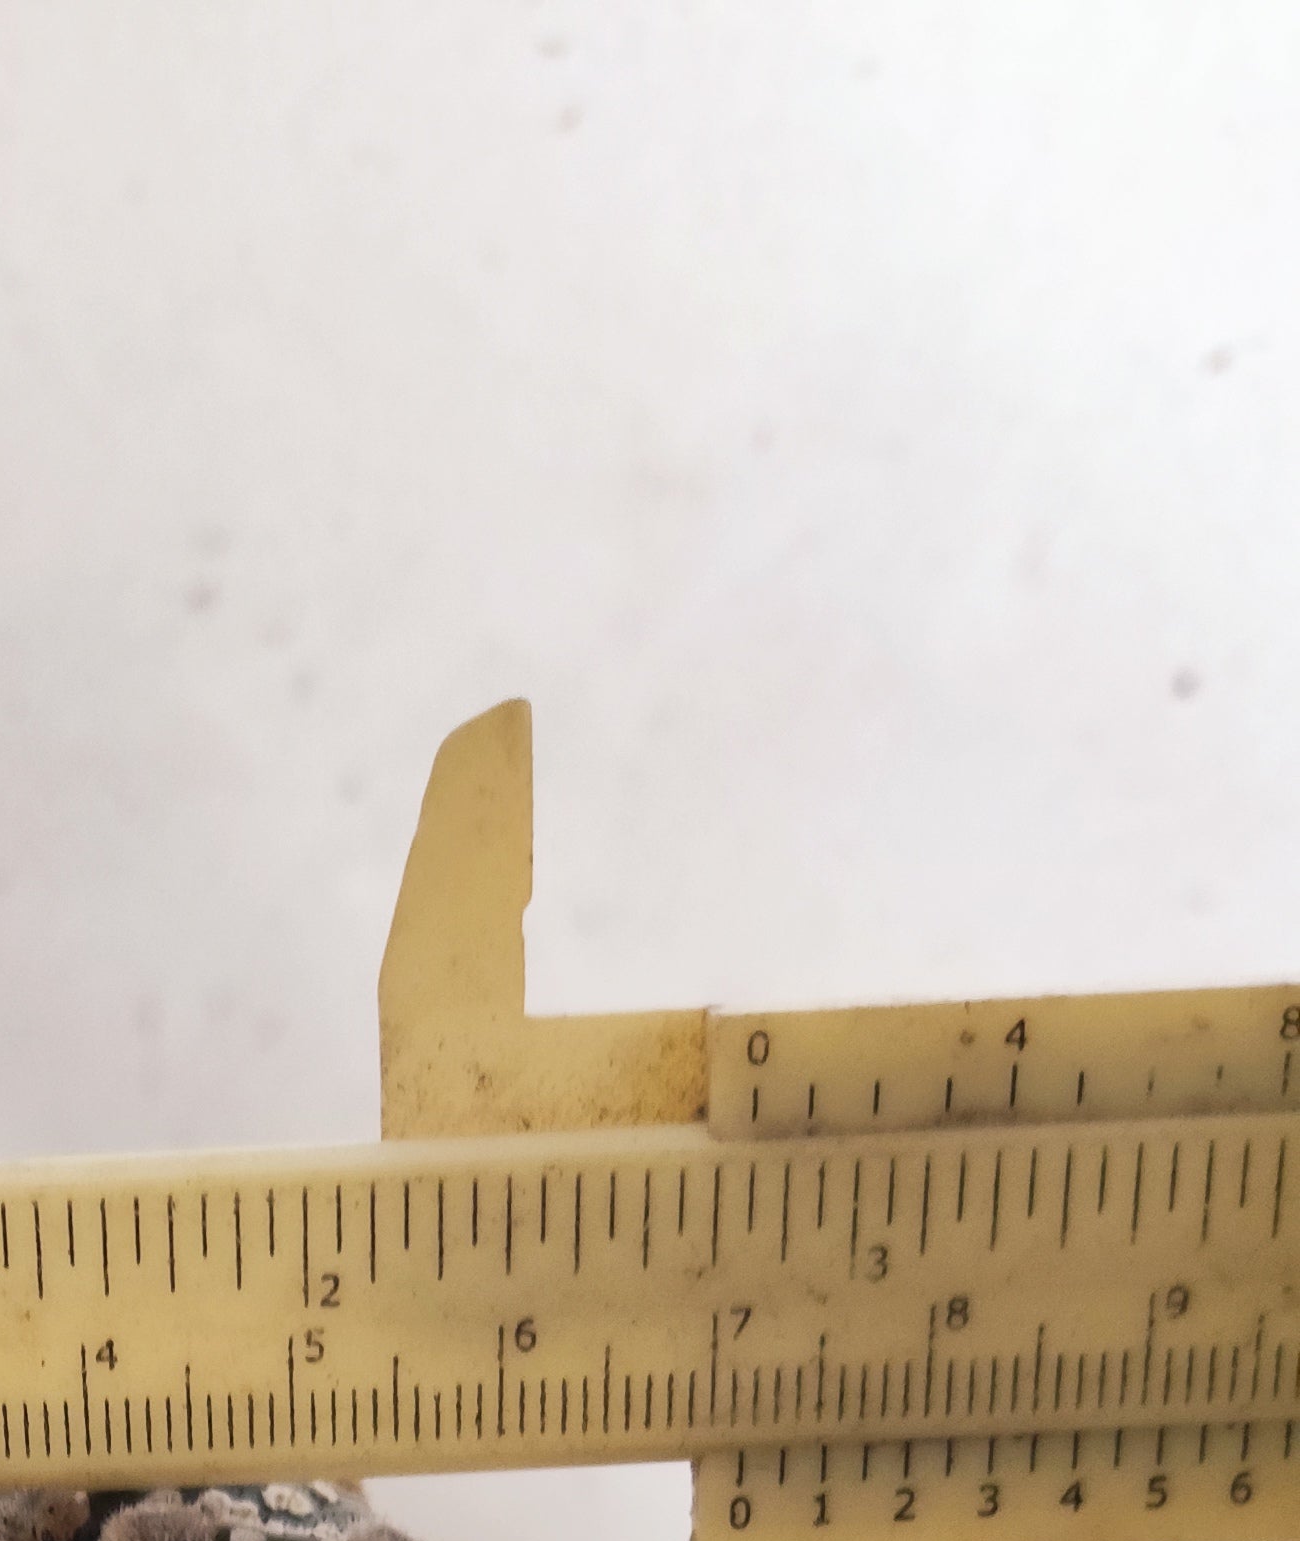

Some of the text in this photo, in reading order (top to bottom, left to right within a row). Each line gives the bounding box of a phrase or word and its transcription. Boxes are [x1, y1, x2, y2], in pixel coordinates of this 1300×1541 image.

[746, 1004, 1300, 1066] 0 4 8
[319, 1273, 341, 1308] 2
[867, 1244, 890, 1281] 3
[94, 1338, 119, 1372] 4
[304, 1328, 326, 1363] 5
[513, 1317, 538, 1351] 6
[730, 1305, 753, 1341] 7
[944, 1295, 971, 1331] 8
[1166, 1284, 1190, 1320] 9
[729, 1471, 1253, 1530] 0 1 2 3 4 5 6
